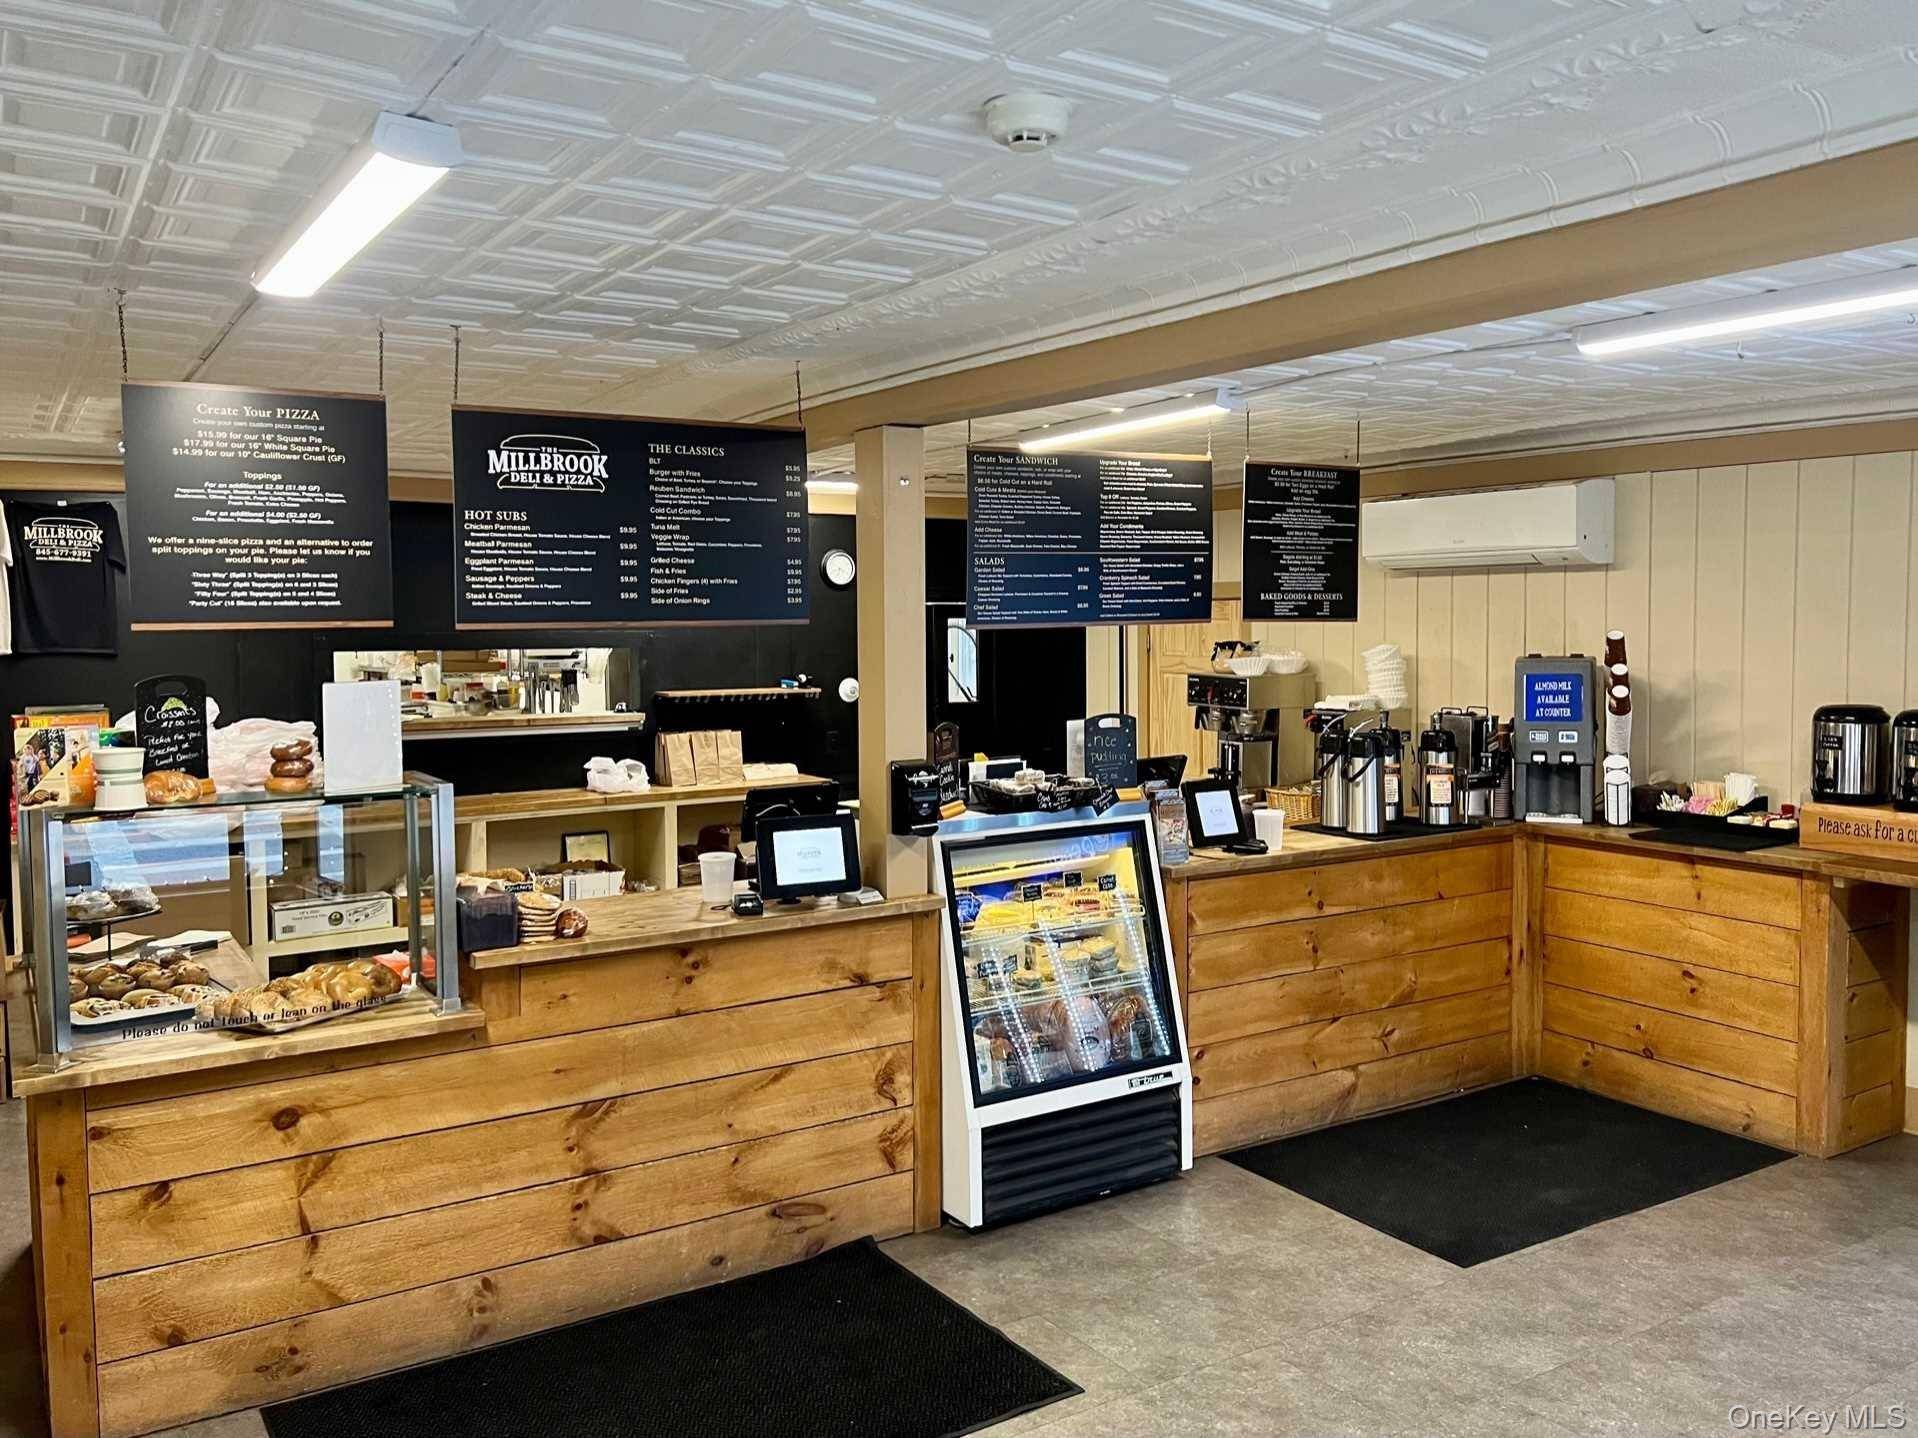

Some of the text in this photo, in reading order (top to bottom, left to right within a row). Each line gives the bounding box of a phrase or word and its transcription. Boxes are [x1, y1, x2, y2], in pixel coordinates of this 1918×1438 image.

[196, 404, 320, 420] Create Your PIZZA
[277, 434, 306, 444] Square
[264, 443, 288, 451] White
[290, 444, 319, 453] Square
[648, 444, 725, 457] THE CLASSICS
[205, 448, 217, 456] for
[253, 451, 300, 460] Cauliflower
[328, 454, 345, 463] (GF)
[974, 454, 1058, 465] Create Your SANDWICH
[487, 449, 608, 479] MILLBROOK
[243, 471, 282, 481] Toppings
[649, 469, 670, 477] Burger
[1271, 468, 1288, 476] Create
[1303, 470, 1337, 479] BREAKFAST
[511, 472, 594, 485] DELI & PIZZA
[464, 510, 527, 521] HOT SUBS
[24, 526, 103, 544] MILLBROOK
[197, 537, 238, 545] nine-slice
[241, 538, 263, 546] pizza
[266, 538, 282, 546] and
[297, 539, 339, 547] alternative
[342, 539, 349, 547] to
[152, 546, 171, 554] split
[174, 546, 213, 555] toppings
[270, 547, 298, 555] Please
[356, 549, 370, 557] you
[254, 556, 268, 564] like
[464, 558, 497, 566] Eggplant
[975, 557, 1004, 565] SALADS
[465, 575, 497, 583] Sausage
[505, 575, 534, 583] Peppers
[1534, 681, 1572, 691] ALMOND MILK
[1537, 695, 1570, 704] AVAILABLE
[1536, 708, 1571, 717] AT COUNTER
[1819, 817, 1851, 835] Please
[1854, 821, 1872, 838] ask
[1875, 820, 1894, 840] for
[1897, 828, 1904, 842] a
[123, 1027, 167, 1040] Please
[173, 1022, 189, 1033] do
[194, 1019, 215, 1031] not
[222, 1013, 258, 1027] touch
[264, 1012, 276, 1021] or
[281, 1008, 307, 1019] lean
[312, 1005, 326, 1014] on
[332, 999, 351, 1011] the
